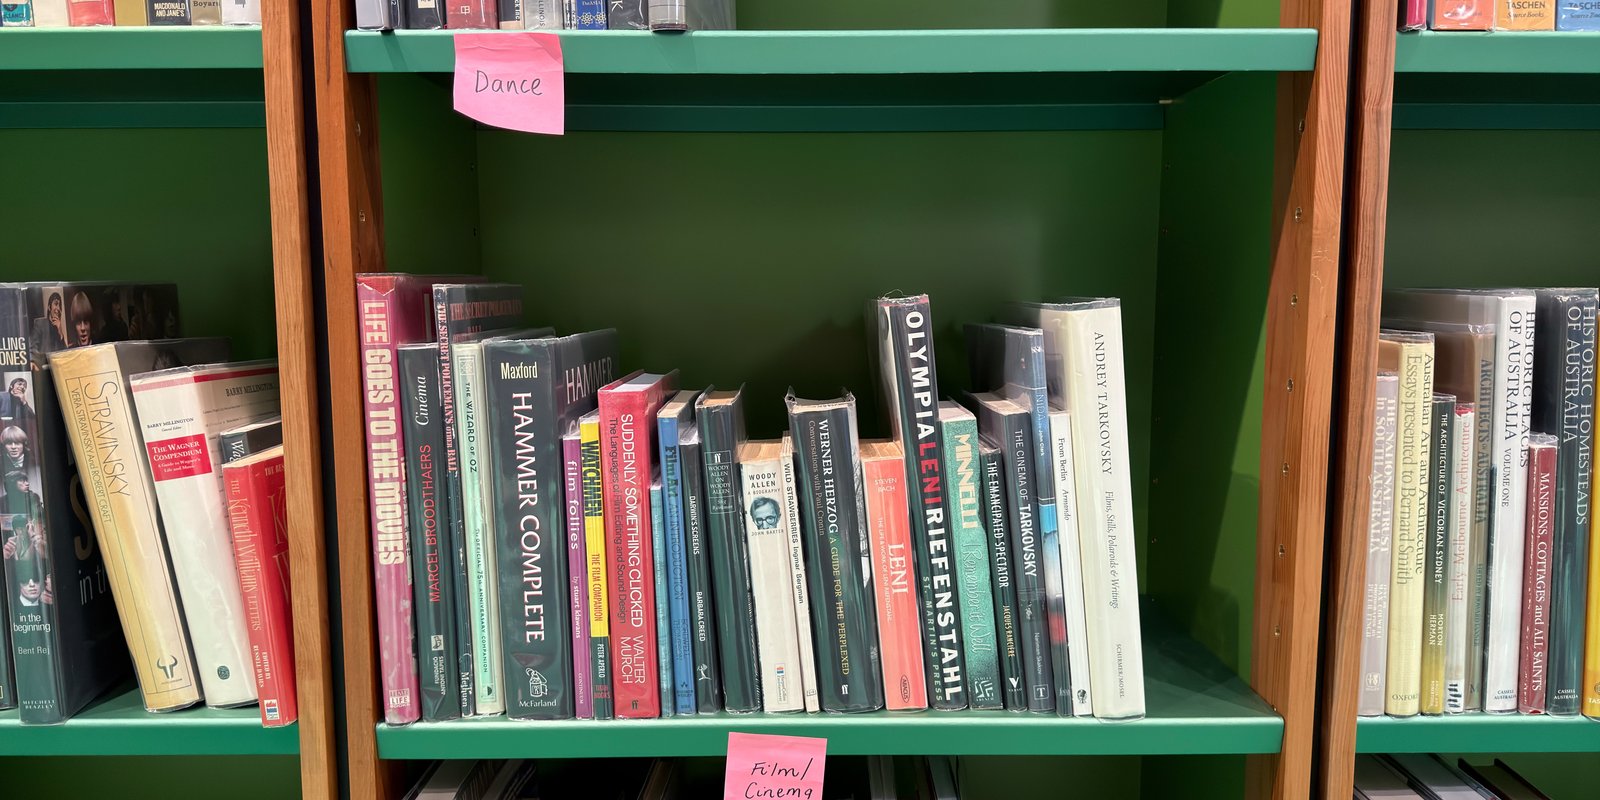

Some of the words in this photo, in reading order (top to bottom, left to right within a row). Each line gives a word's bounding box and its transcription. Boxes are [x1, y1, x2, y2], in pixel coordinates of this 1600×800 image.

[474, 70, 543, 96] Dance
[363, 302, 386, 344] LIFE
[437, 304, 446, 323] THE
[1509, 311, 1522, 334] OF
[1568, 306, 1581, 331] OF
[438, 324, 449, 362] SECRET
[1094, 332, 1107, 386] ANDREY
[1522, 311, 1536, 398] HISTORIC
[1581, 306, 1595, 396] HISTORIC
[365, 348, 395, 404] GOES
[501, 362, 538, 380] Maxford
[566, 356, 613, 404] HAMMER
[905, 311, 935, 440] OLYMPIA
[1406, 355, 1422, 398] Essays
[1422, 354, 1433, 426] Australian
[1504, 339, 1521, 441] AUSTRALIA
[1563, 338, 1580, 444] AUSTRALIA
[415, 375, 428, 426] Cinéma
[441, 362, 454, 424] POLICEMAN'S
[1386, 398, 1395, 427] THE
[84, 381, 130, 496] STRAVINSKY
[162, 418, 194, 426] MILLINGTON
[369, 406, 397, 436] TO
[610, 418, 618, 435] The
[1015, 429, 1023, 448] THE
[1098, 394, 1112, 475] TARKOVSKY
[1402, 400, 1418, 467] presented
[1520, 403, 1531, 468] PLACES
[371, 438, 400, 479] THE
[447, 449, 457, 473] BALL
[512, 392, 538, 510] HAMMER
[609, 436, 619, 483] Languages
[621, 414, 637, 485] SUDDENLY
[666, 446, 677, 478] Film
[808, 420, 819, 471] Conversations
[818, 419, 833, 475] WERNER
[1421, 432, 1431, 456] Art
[1439, 428, 1447, 484] ARCHITECTURE
[567, 460, 578, 491] film
[581, 440, 602, 517] WATCHMEN
[749, 472, 776, 480] WOODY
[751, 480, 776, 488] ALLEN
[918, 442, 942, 504] LENI
[955, 433, 978, 529] MINNELLI
[987, 461, 997, 477] THE
[1016, 450, 1026, 487] CINEMA
[1382, 431, 1394, 504] NATIONAL
[1402, 471, 1412, 483] to
[1420, 460, 1429, 485] and
[1503, 448, 1511, 487] VOLUME
[1576, 404, 1591, 525] HOMESTEADS
[230, 480, 240, 496] THE
[420, 444, 437, 546] BROODTHAERS
[613, 484, 620, 493] of
[668, 478, 678, 498] Art
[824, 477, 839, 534] HERZOG
[1020, 488, 1028, 500] OF
[1062, 489, 1071, 520] Armando
[1105, 491, 1114, 514] Films,
[1439, 484, 1446, 494] OF
[1502, 488, 1510, 507] ONE
[1537, 472, 1550, 538] MANSIONS,
[228, 498, 257, 542] Kenneth
[374, 482, 405, 566] MOVIES
[569, 500, 579, 550] follies
[625, 487, 640, 567] SOMETHING
[670, 503, 679, 516] AN
[787, 487, 798, 543] STRAWBERRIES
[989, 480, 1003, 539] EMANCIPATED
[1106, 514, 1116, 533] Stills,
[1398, 487, 1416, 541] Bernard
[1436, 500, 1445, 548] VICTORIAN
[614, 514, 624, 546] Editing
[1019, 504, 1036, 577] TARKOVSKY
[1380, 508, 1391, 552] TRUST
[1416, 489, 1427, 574] Architecture
[238, 544, 260, 593] Williams
[591, 553, 600, 566] THE
[671, 517, 683, 600] INTRODUCTION
[830, 548, 840, 576] GUIDE
[888, 544, 908, 594] LENI
[995, 541, 1009, 588] SPECTATOR
[1108, 535, 1117, 568] Polaroids
[1397, 545, 1415, 585] Smith
[1434, 550, 1443, 584] SYDNEY
[426, 550, 440, 602] MARCEL
[520, 515, 545, 643] COMPLETE
[592, 567, 601, 582] FILM
[618, 564, 626, 590] Sound
[833, 580, 841, 597] FOR
[1111, 570, 1117, 578] &
[1536, 542, 1547, 602] COTTAGES
[248, 596, 262, 631] LETTERS
[592, 584, 602, 622] COMPANION
[617, 591, 626, 624] Design
[629, 568, 643, 627] CLICKED
[696, 591, 704, 620] BARBARA
[836, 601, 844, 619] THE
[926, 508, 962, 701] RIEFENSTAHL
[1109, 579, 1120, 609] Writings
[13, 622, 50, 634] beginning
[19, 613, 27, 622] in
[28, 613, 42, 622] the
[1535, 604, 1544, 625] and
[18, 646, 34, 655] Bent
[838, 623, 849, 675] PERPLEXED
[926, 601, 938, 657] MARTIN'S
[933, 665, 942, 701] PRESS
[1534, 628, 1543, 649] ALL
[621, 636, 633, 684] MURCH
[634, 636, 645, 684] WALTER
[1532, 652, 1543, 691] SAINTS
[460, 672, 468, 708] Methuen
[751, 758, 813, 780] Film/
[744, 782, 813, 800] Cinema
